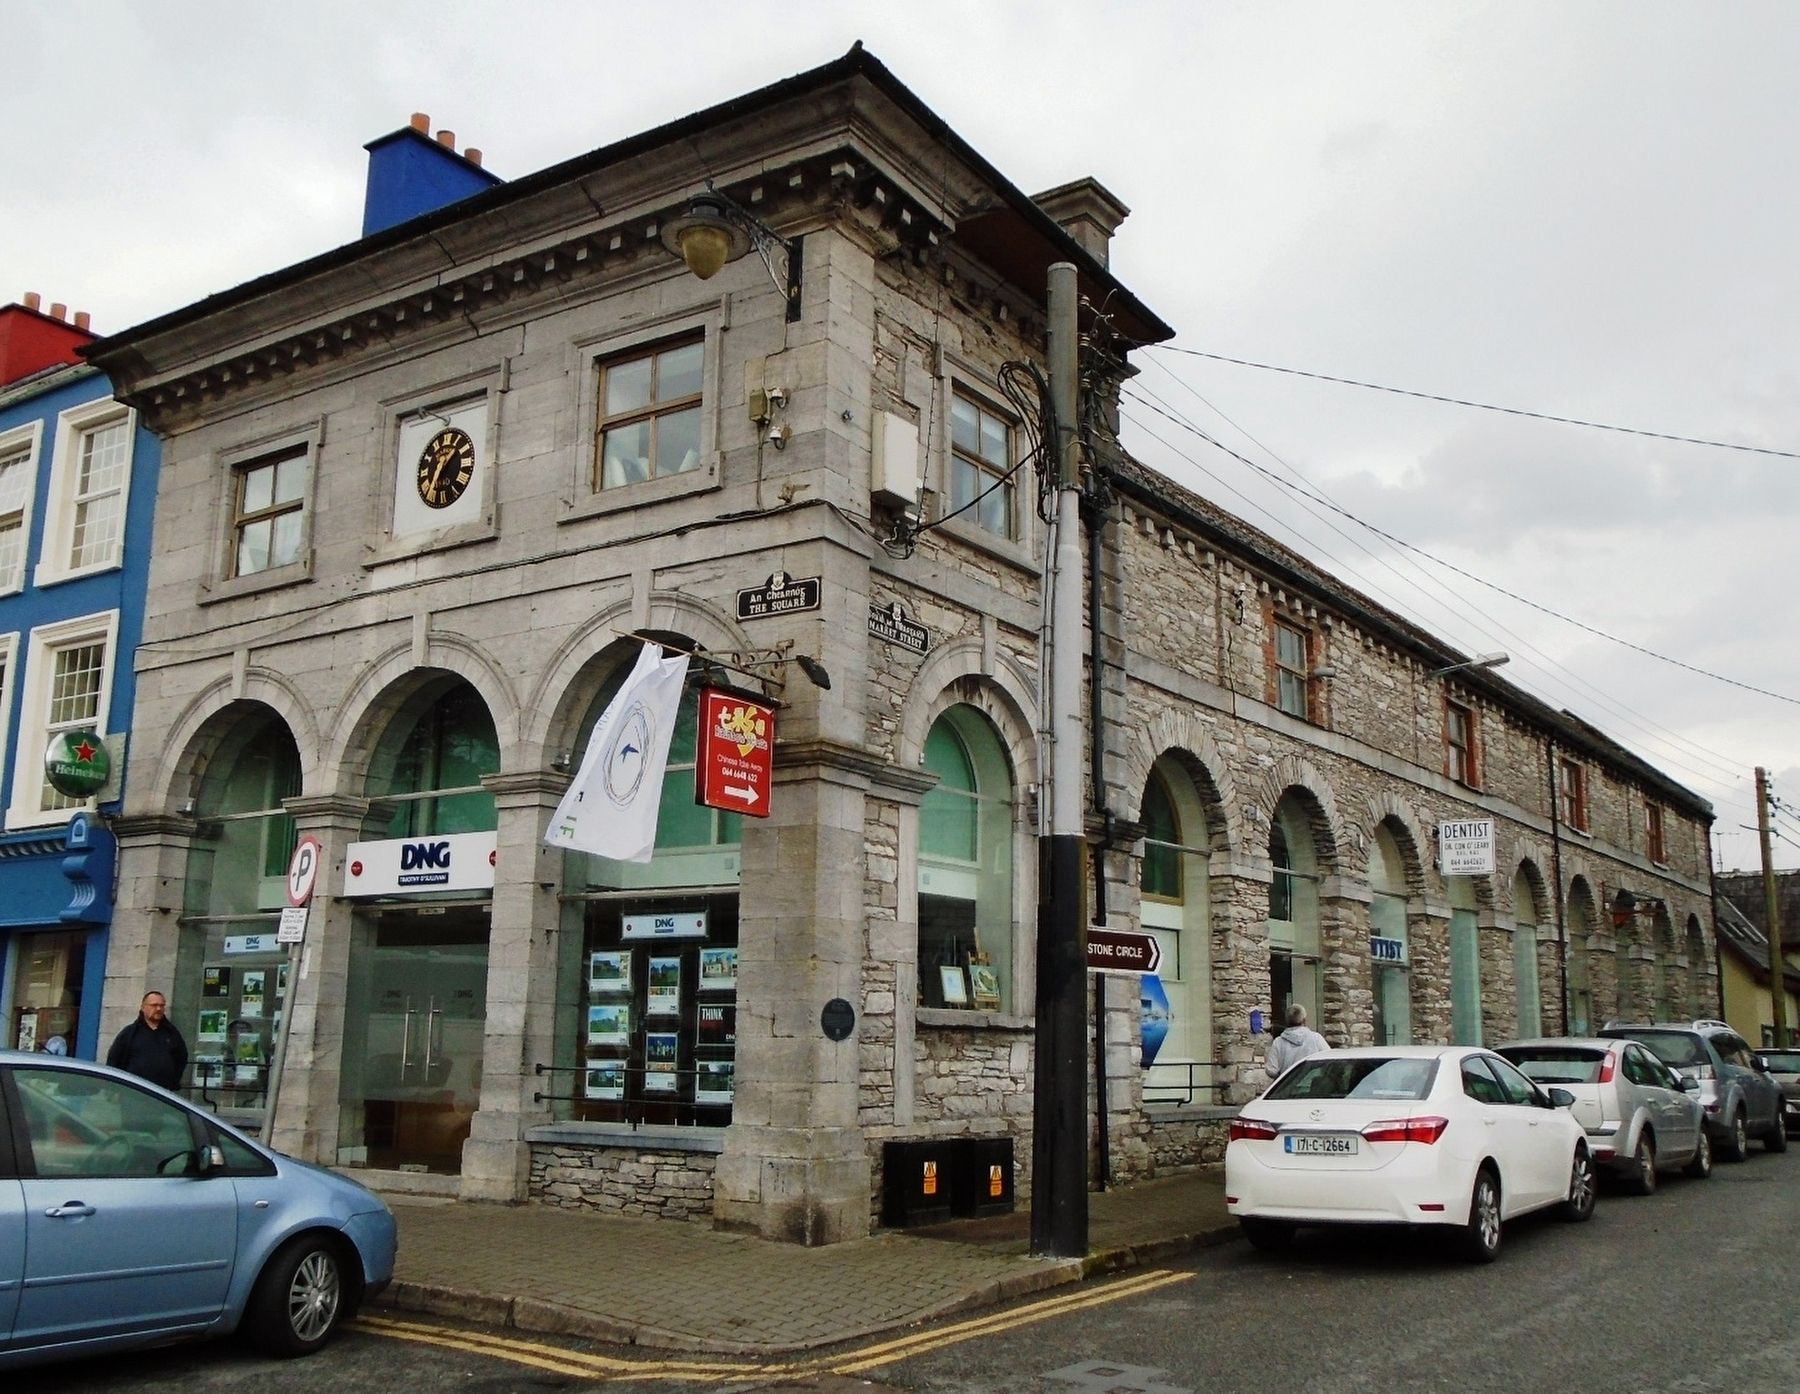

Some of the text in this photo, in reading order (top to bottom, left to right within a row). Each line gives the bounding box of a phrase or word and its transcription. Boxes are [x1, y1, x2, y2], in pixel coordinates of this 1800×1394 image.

[750, 593, 762, 604] An
[749, 598, 806, 614] THE SQUARE
[869, 619, 922, 649] MARKET STREET
[716, 753, 738, 767] Chinese
[721, 766, 733, 777] 064
[1444, 822, 1489, 839] DENTIST
[401, 841, 451, 870] DNG
[654, 917, 674, 928] DNG
[245, 936, 260, 945] DNG
[1087, 943, 1143, 958] STONE CIRCLE
[702, 1008, 723, 1020] THINK
[1297, 1138, 1350, 1152] 171-C-12664
